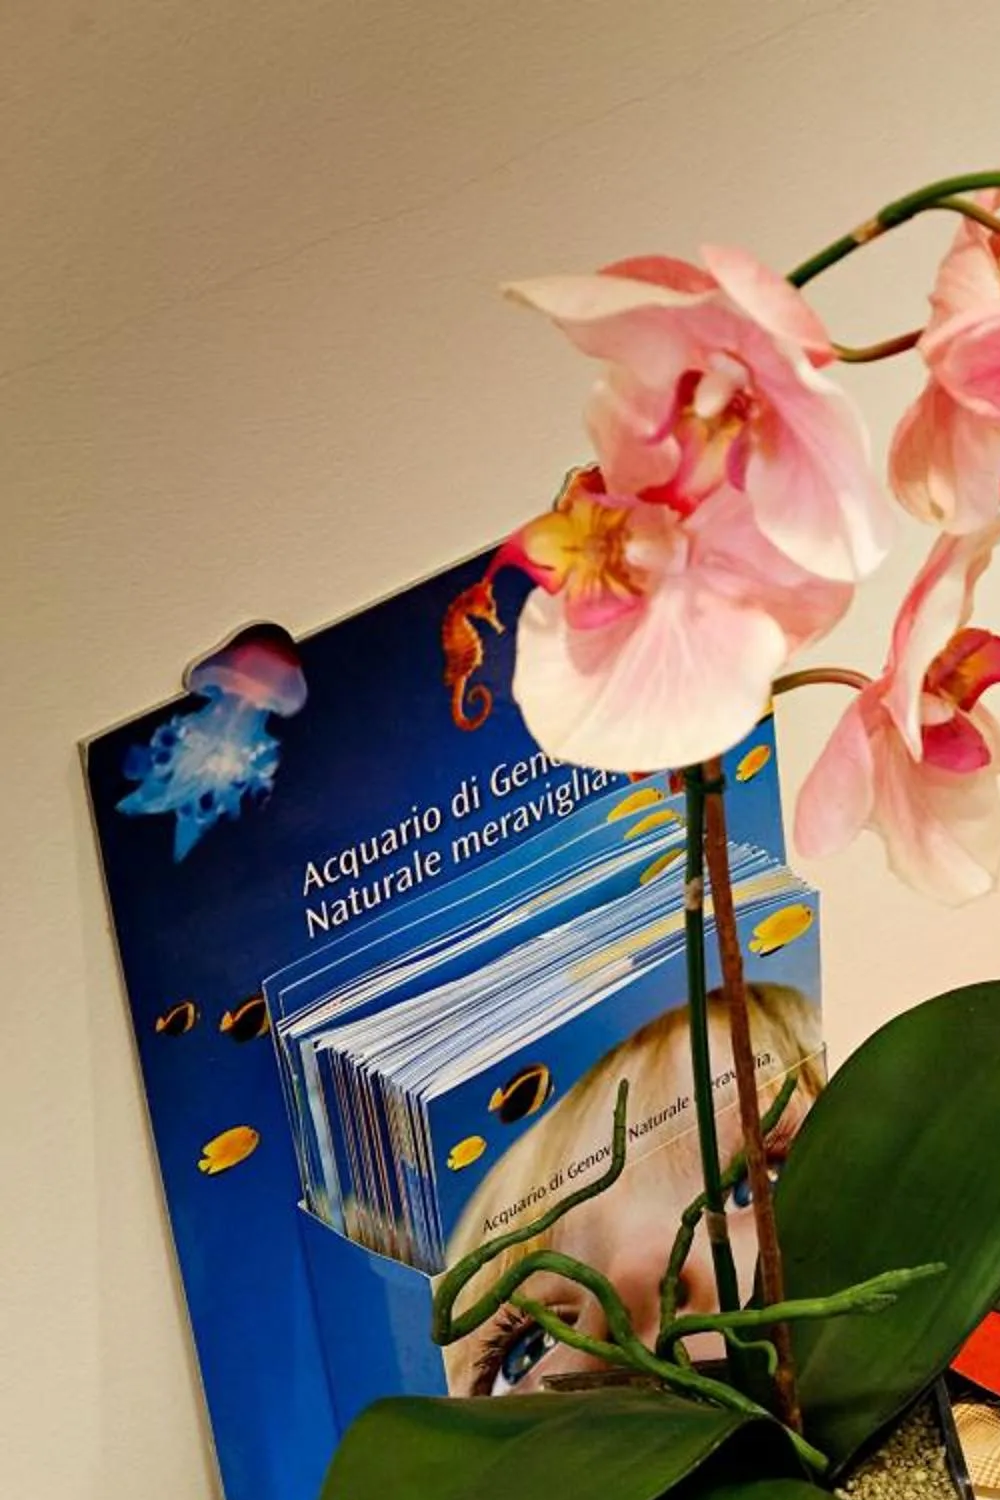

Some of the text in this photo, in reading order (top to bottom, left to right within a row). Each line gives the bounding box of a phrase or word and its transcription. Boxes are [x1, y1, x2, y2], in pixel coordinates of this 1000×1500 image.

[300, 797, 439, 901] Acquario
[447, 774, 484, 819] di
[301, 842, 445, 940] Naturale
[476, 1092, 693, 1234] Acquario di Genov Naturale
